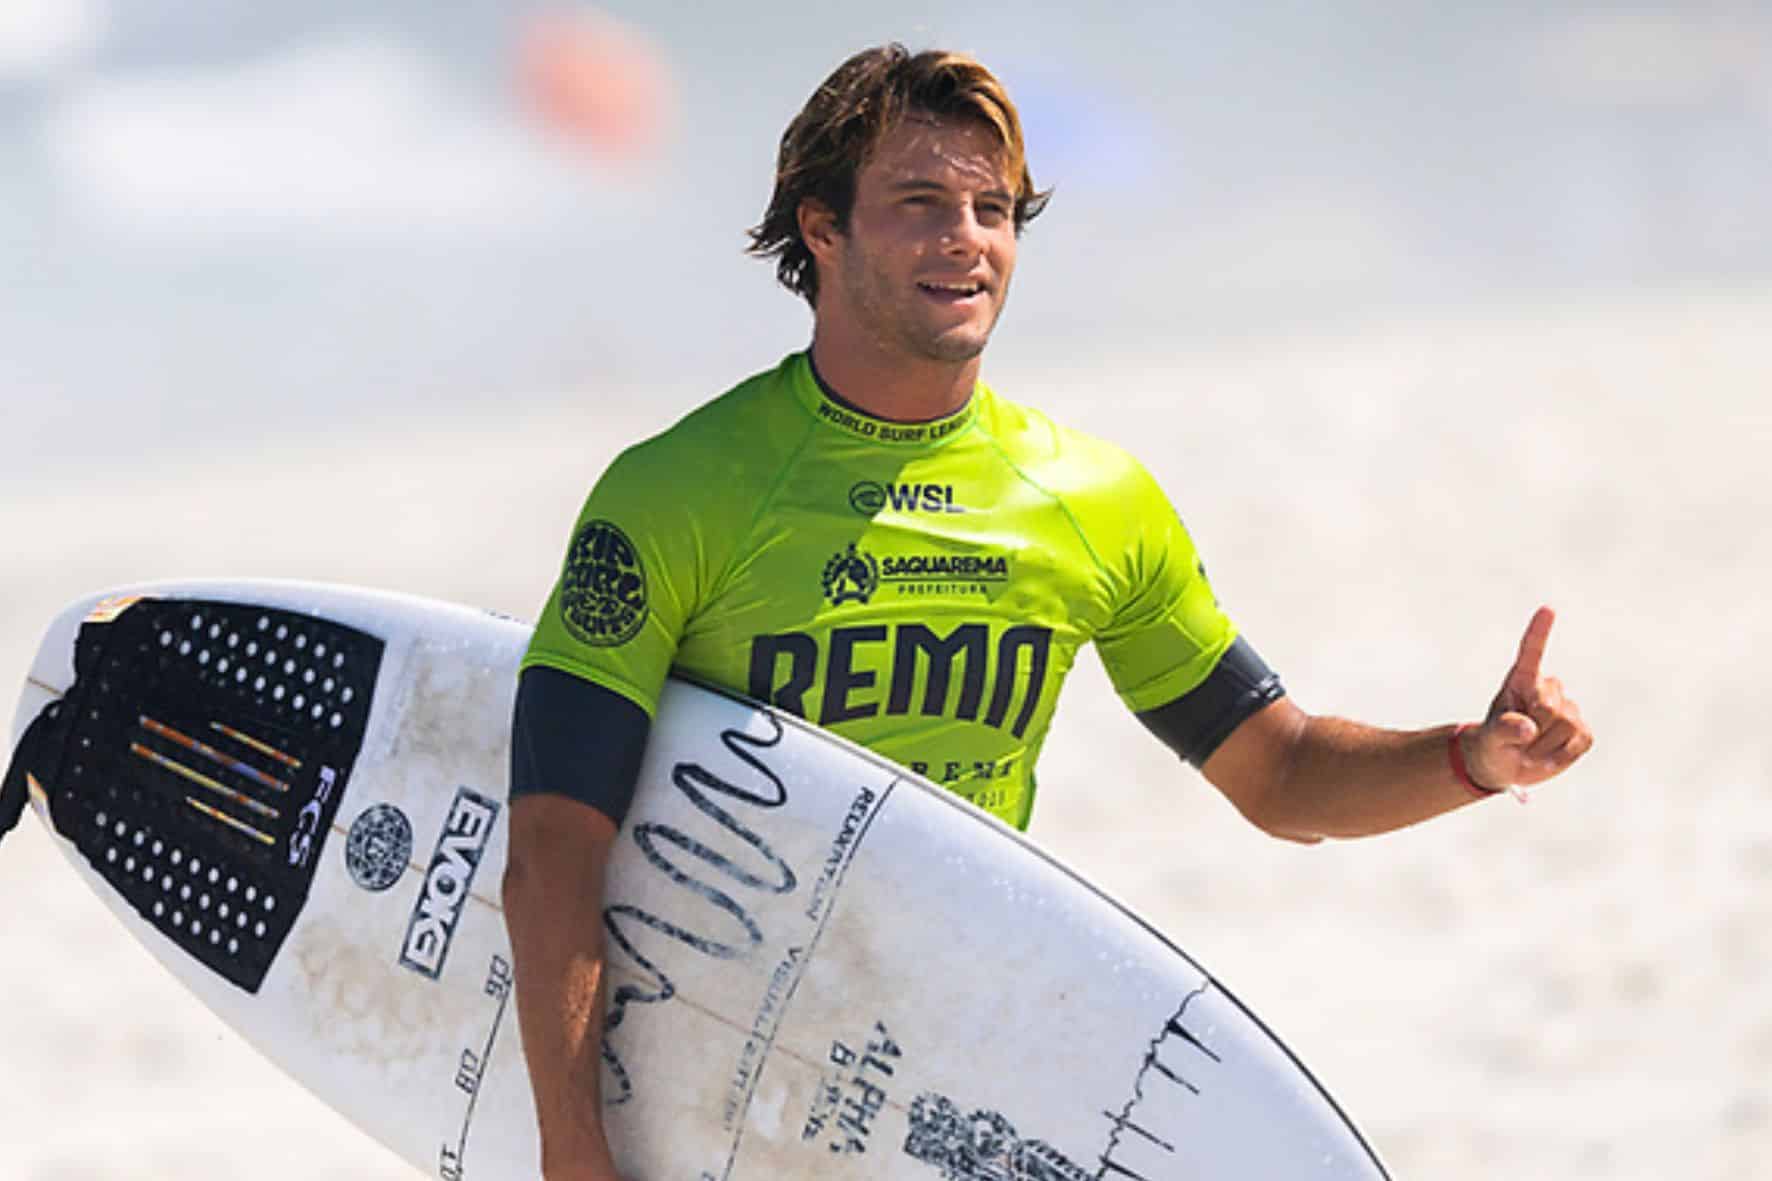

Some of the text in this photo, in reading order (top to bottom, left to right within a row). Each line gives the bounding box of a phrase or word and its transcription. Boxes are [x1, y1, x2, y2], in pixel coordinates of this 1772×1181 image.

[817, 403, 878, 437] WORLD
[879, 426, 927, 441] SURF
[885, 482, 965, 513] WSL
[881, 555, 1008, 577] SAQUAREMA
[288, 765, 336, 868] FCS
[404, 796, 493, 973] EVOKE
